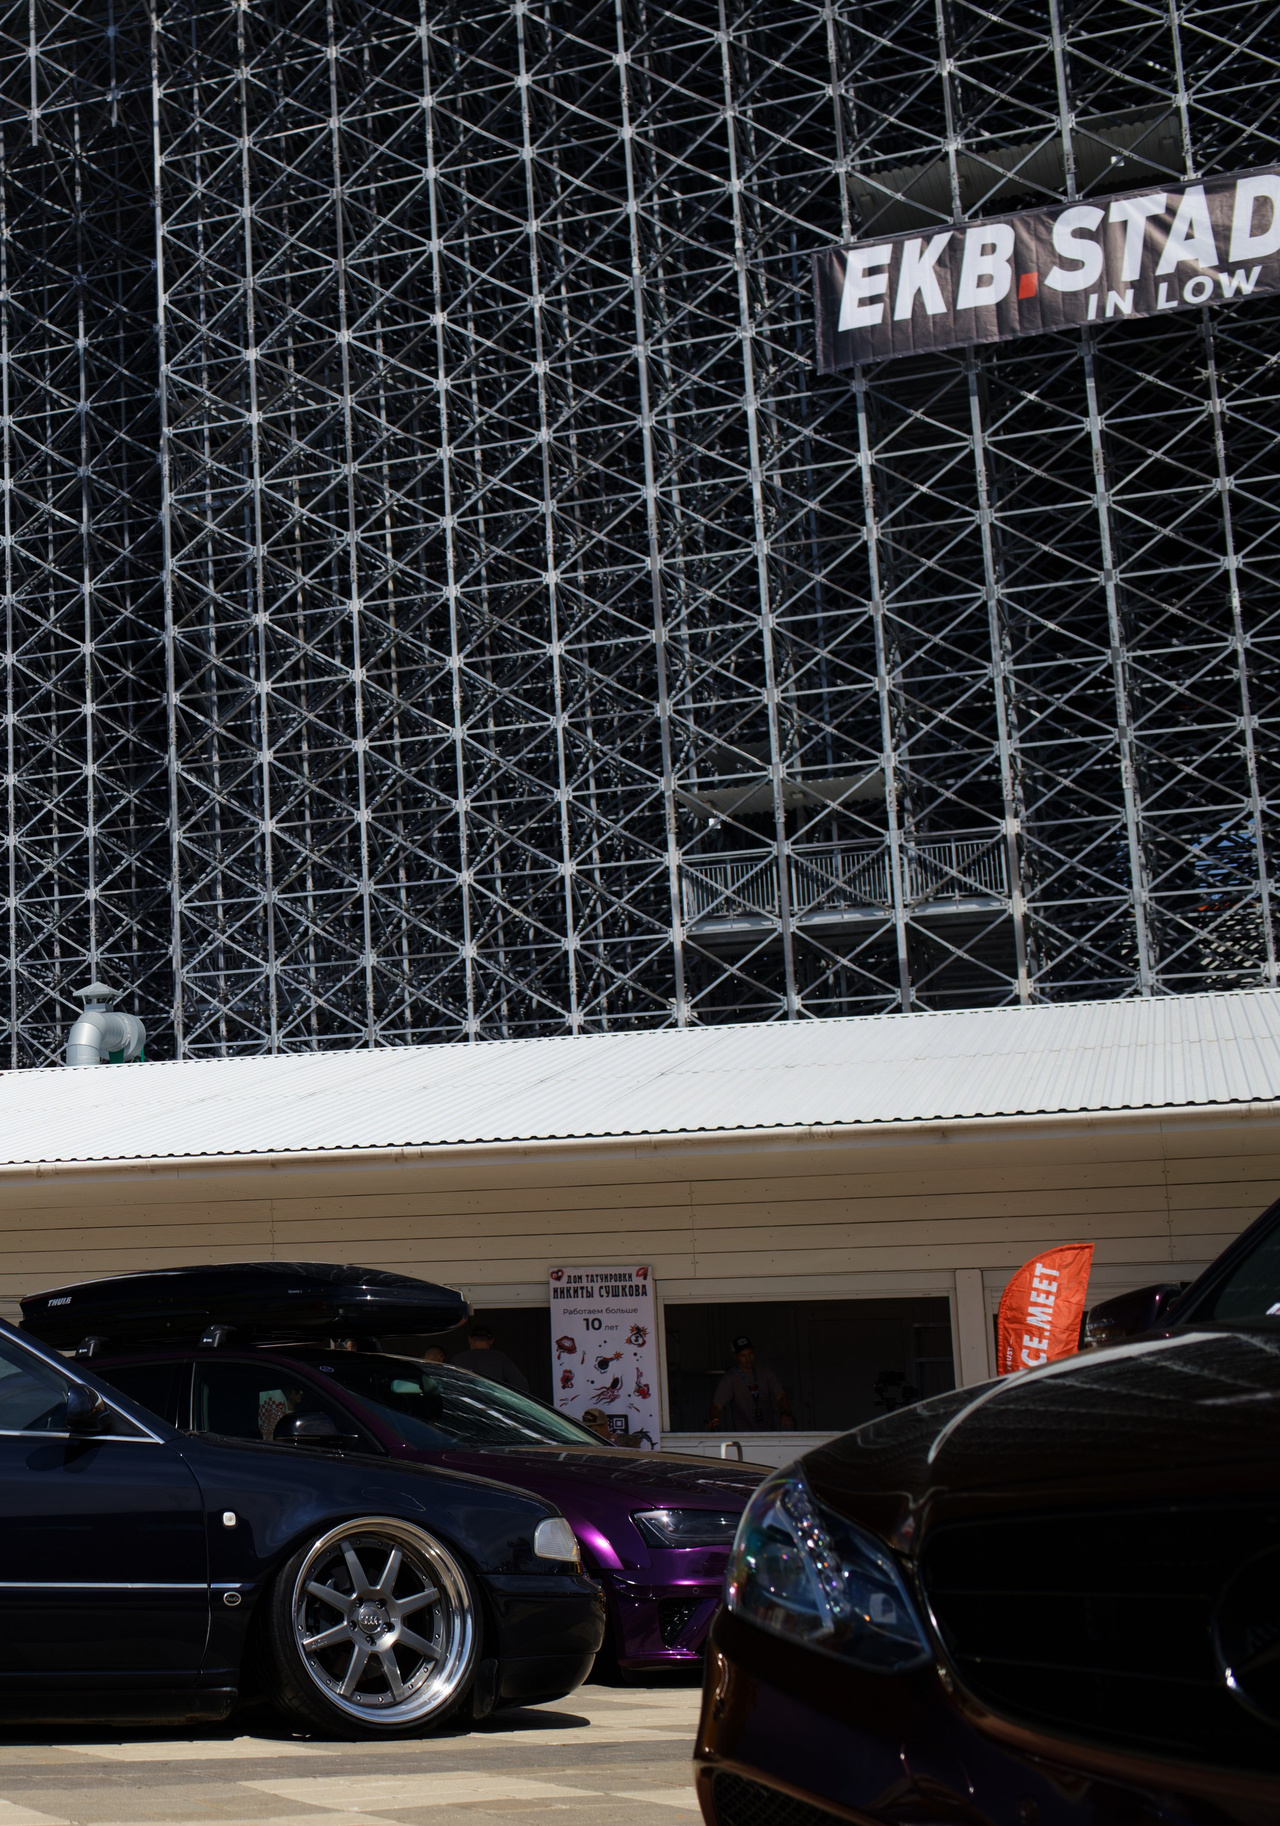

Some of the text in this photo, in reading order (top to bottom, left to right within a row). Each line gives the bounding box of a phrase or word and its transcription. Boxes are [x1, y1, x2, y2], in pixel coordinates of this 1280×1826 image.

[1087, 266, 1262, 320] IN LOW
[566, 1273, 633, 1284] ДОМ ТАТУИРОВКИ
[553, 1284, 648, 1299] НИКИТЫ СУШКОВА
[47, 1296, 73, 1307] THULE
[605, 1307, 639, 1315] больше
[1019, 1263, 1060, 1369] CE.MEET
[583, 1318, 603, 1331] 10
